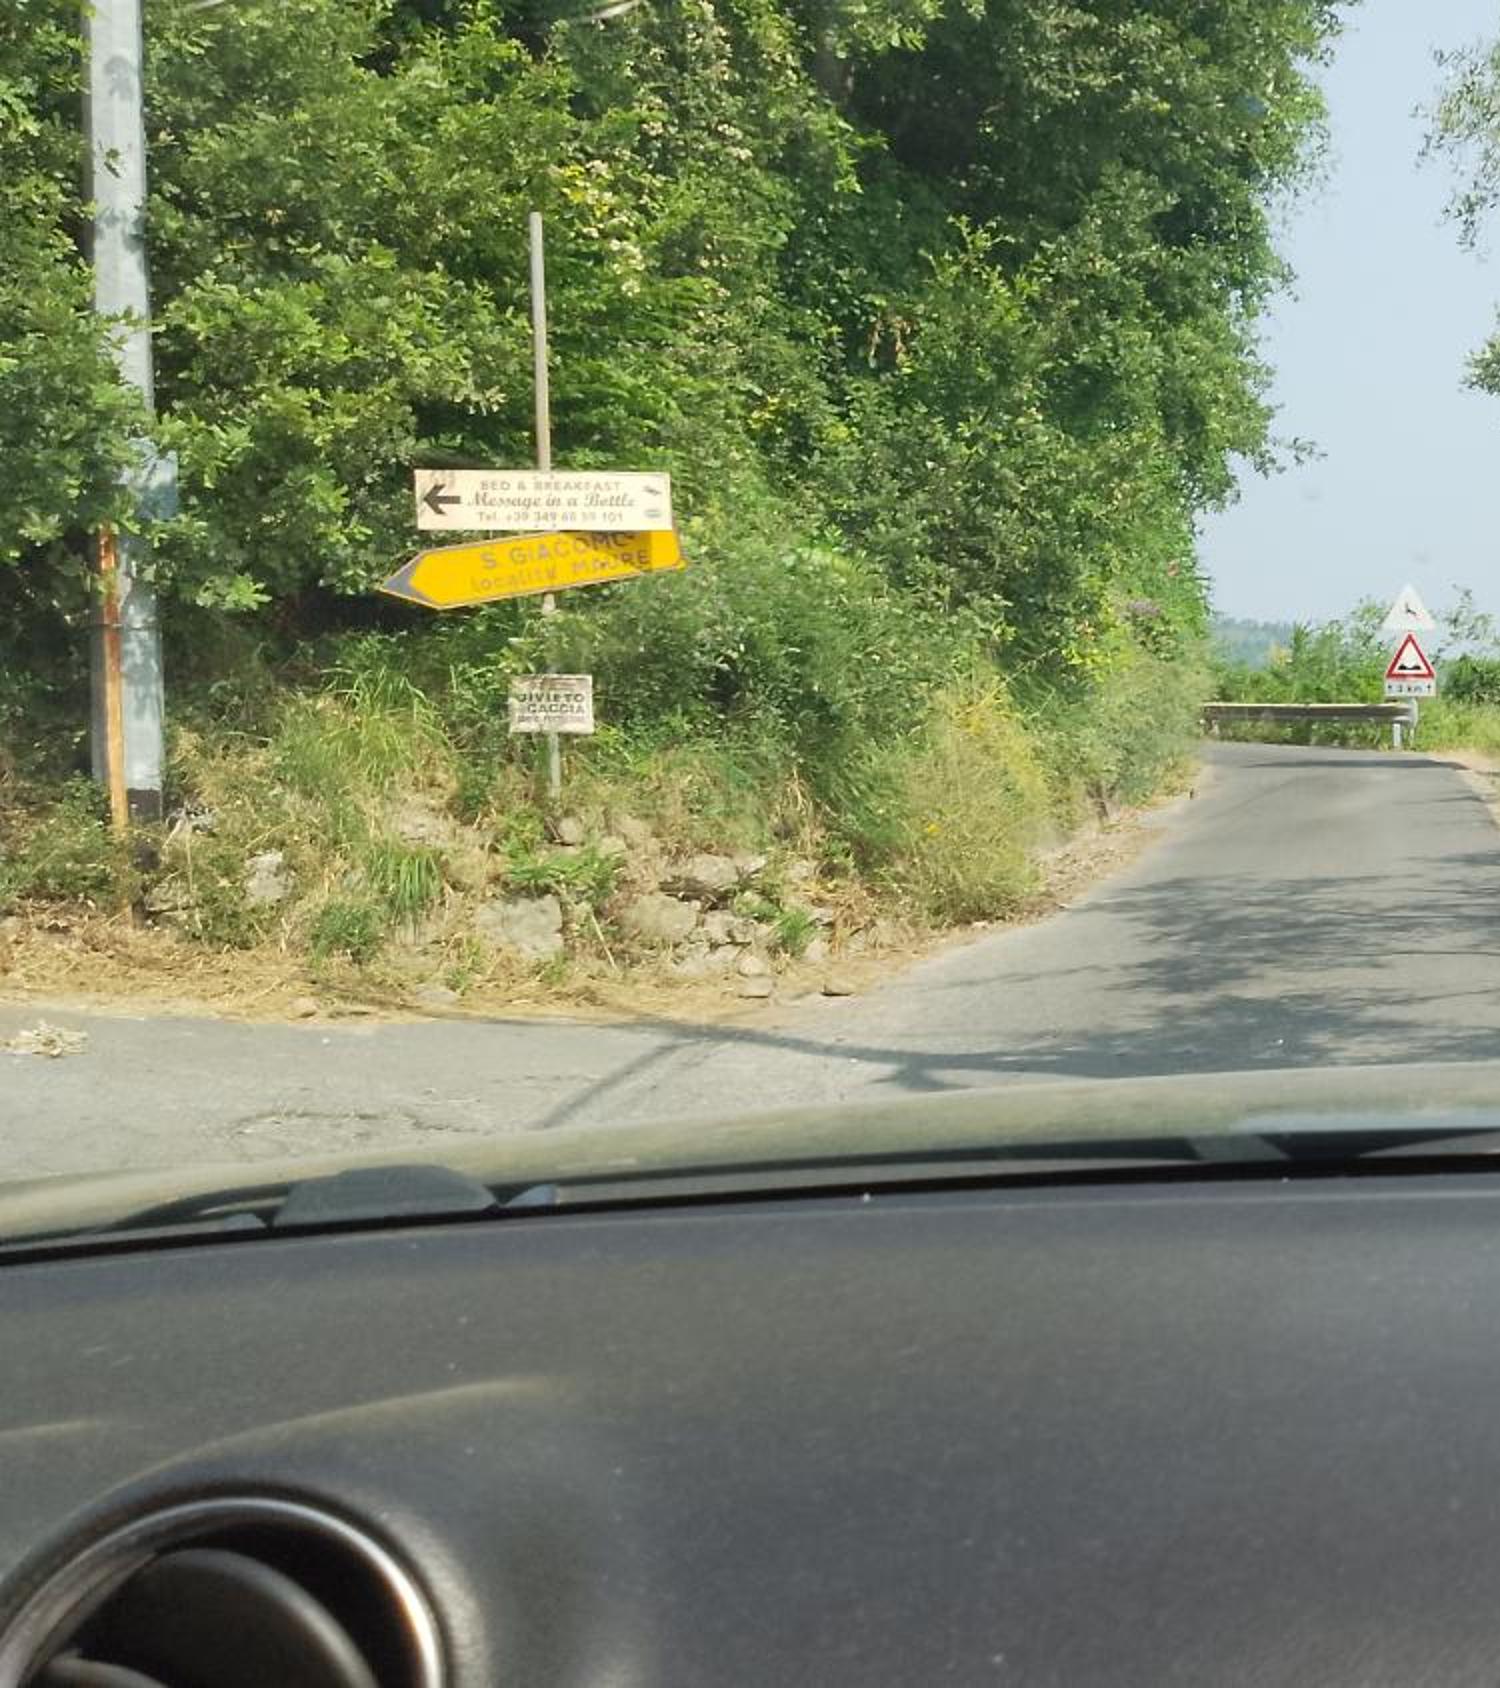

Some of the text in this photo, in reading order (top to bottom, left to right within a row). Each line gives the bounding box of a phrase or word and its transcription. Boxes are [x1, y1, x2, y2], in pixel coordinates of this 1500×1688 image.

[480, 481, 511, 491] BED
[534, 481, 622, 491] BREAKFAST
[468, 492, 636, 509] Message in a Bottle
[527, 703, 586, 713] CACCIA
